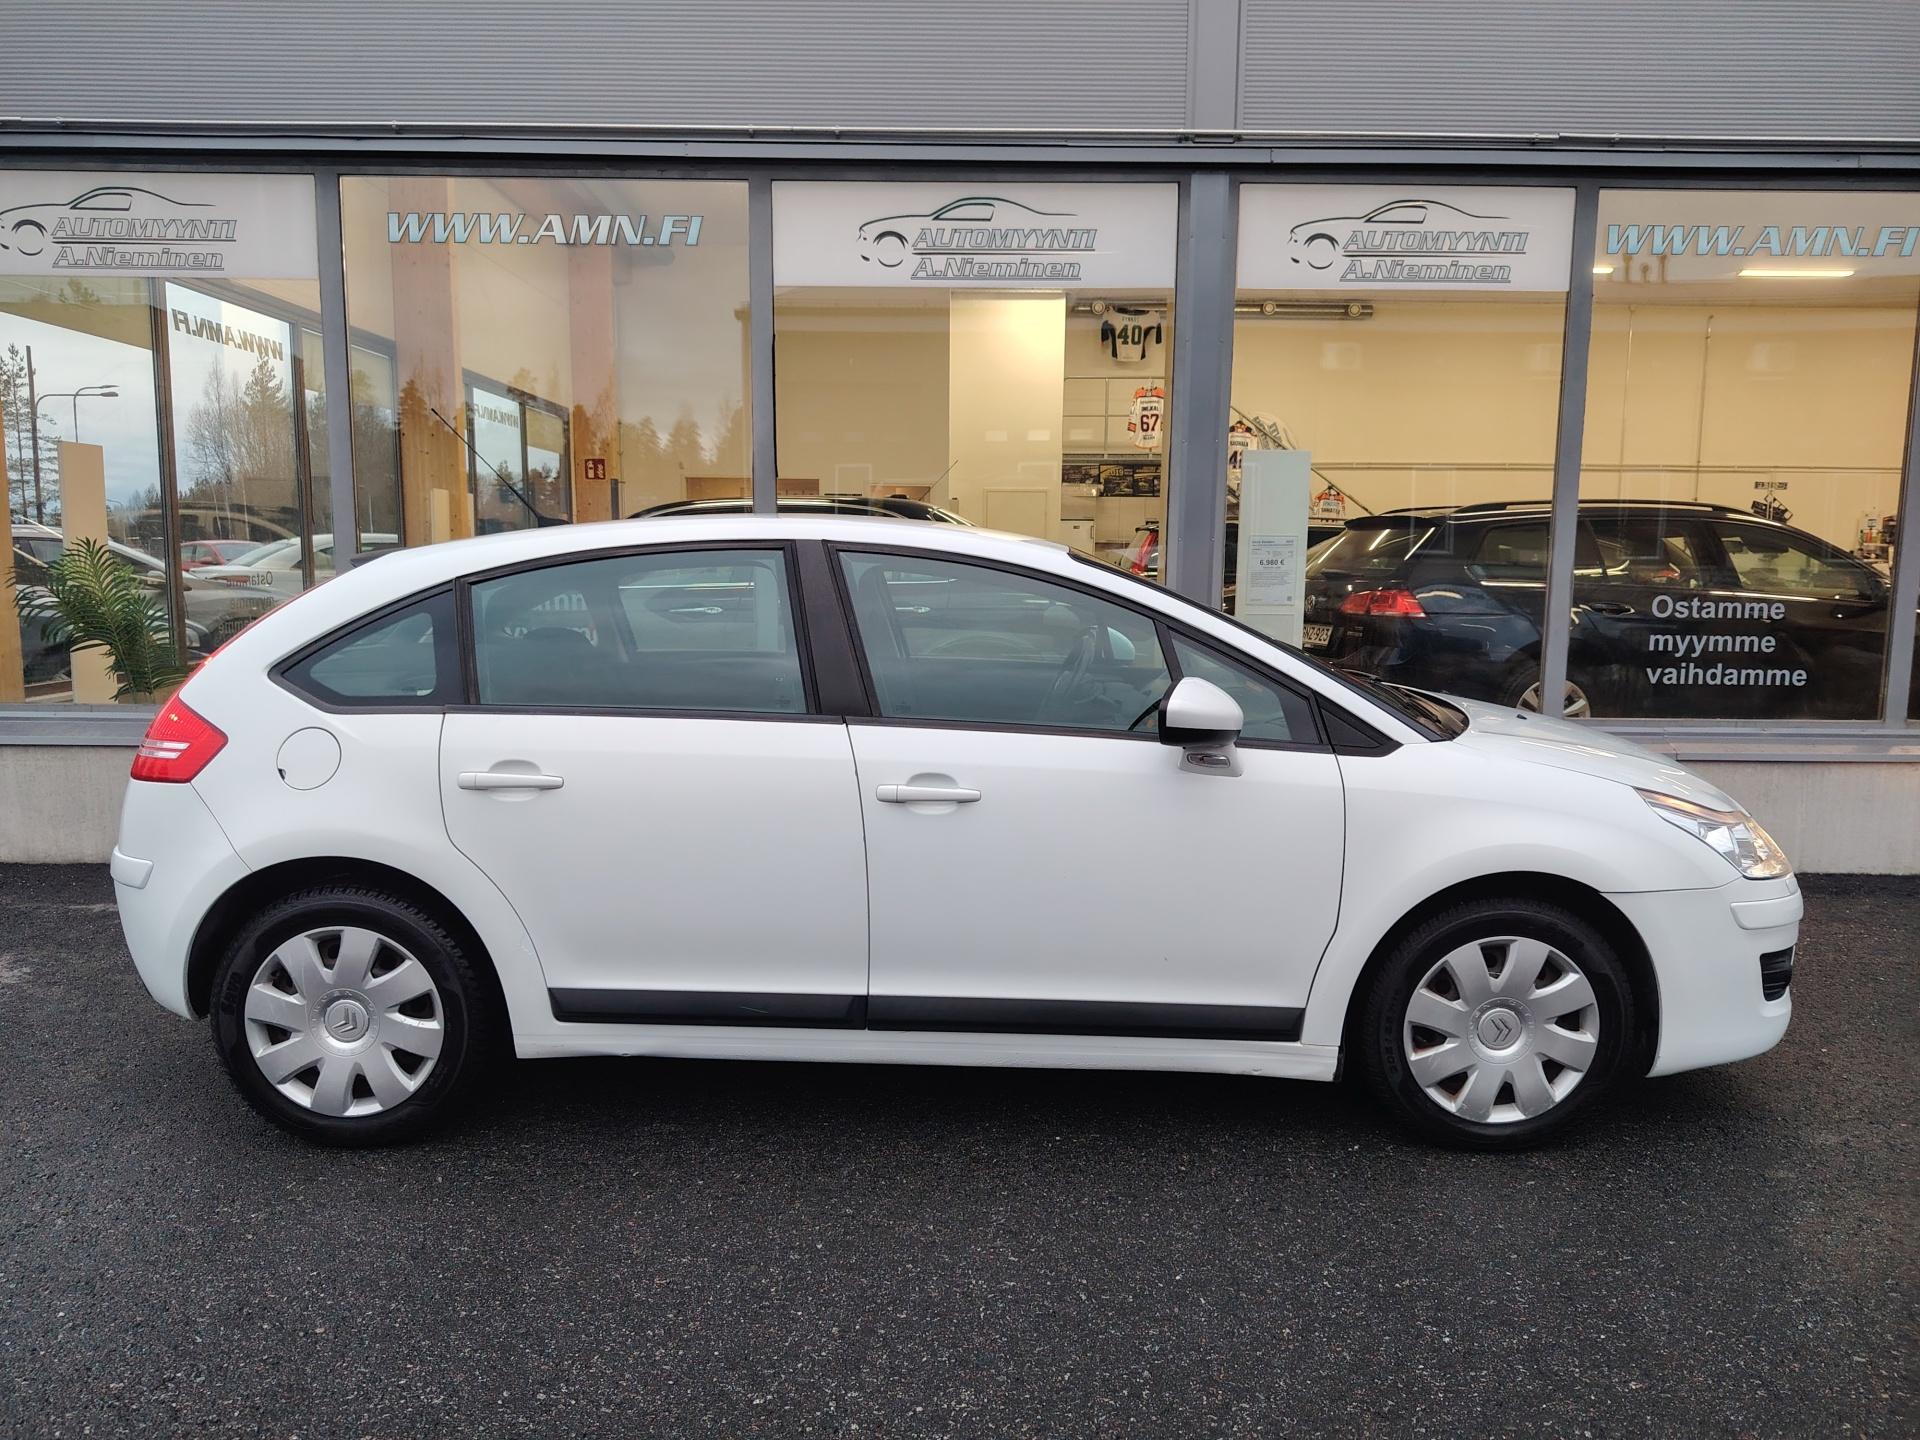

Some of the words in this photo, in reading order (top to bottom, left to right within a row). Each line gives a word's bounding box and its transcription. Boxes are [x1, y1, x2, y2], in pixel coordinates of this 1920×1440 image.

[51, 216, 238, 239] AUTOMYYNTI
[387, 211, 704, 247] WWW.AMN.FI
[912, 228, 1098, 249] AUTOMYYNTI
[1342, 230, 1530, 252] AUTOMYYNTI
[1606, 224, 1920, 257] WWW.AMN.FI
[53, 246, 224, 267] A.Nieminen
[912, 257, 1081, 278] A.Nieminen
[1341, 259, 1511, 280] A.Nieminen
[1117, 324, 1142, 345] 40
[1140, 413, 1159, 432] 67
[1651, 595, 1786, 620] Ostamme
[1648, 633, 1777, 657] myymme
[1646, 663, 1808, 687] vaihdamme
